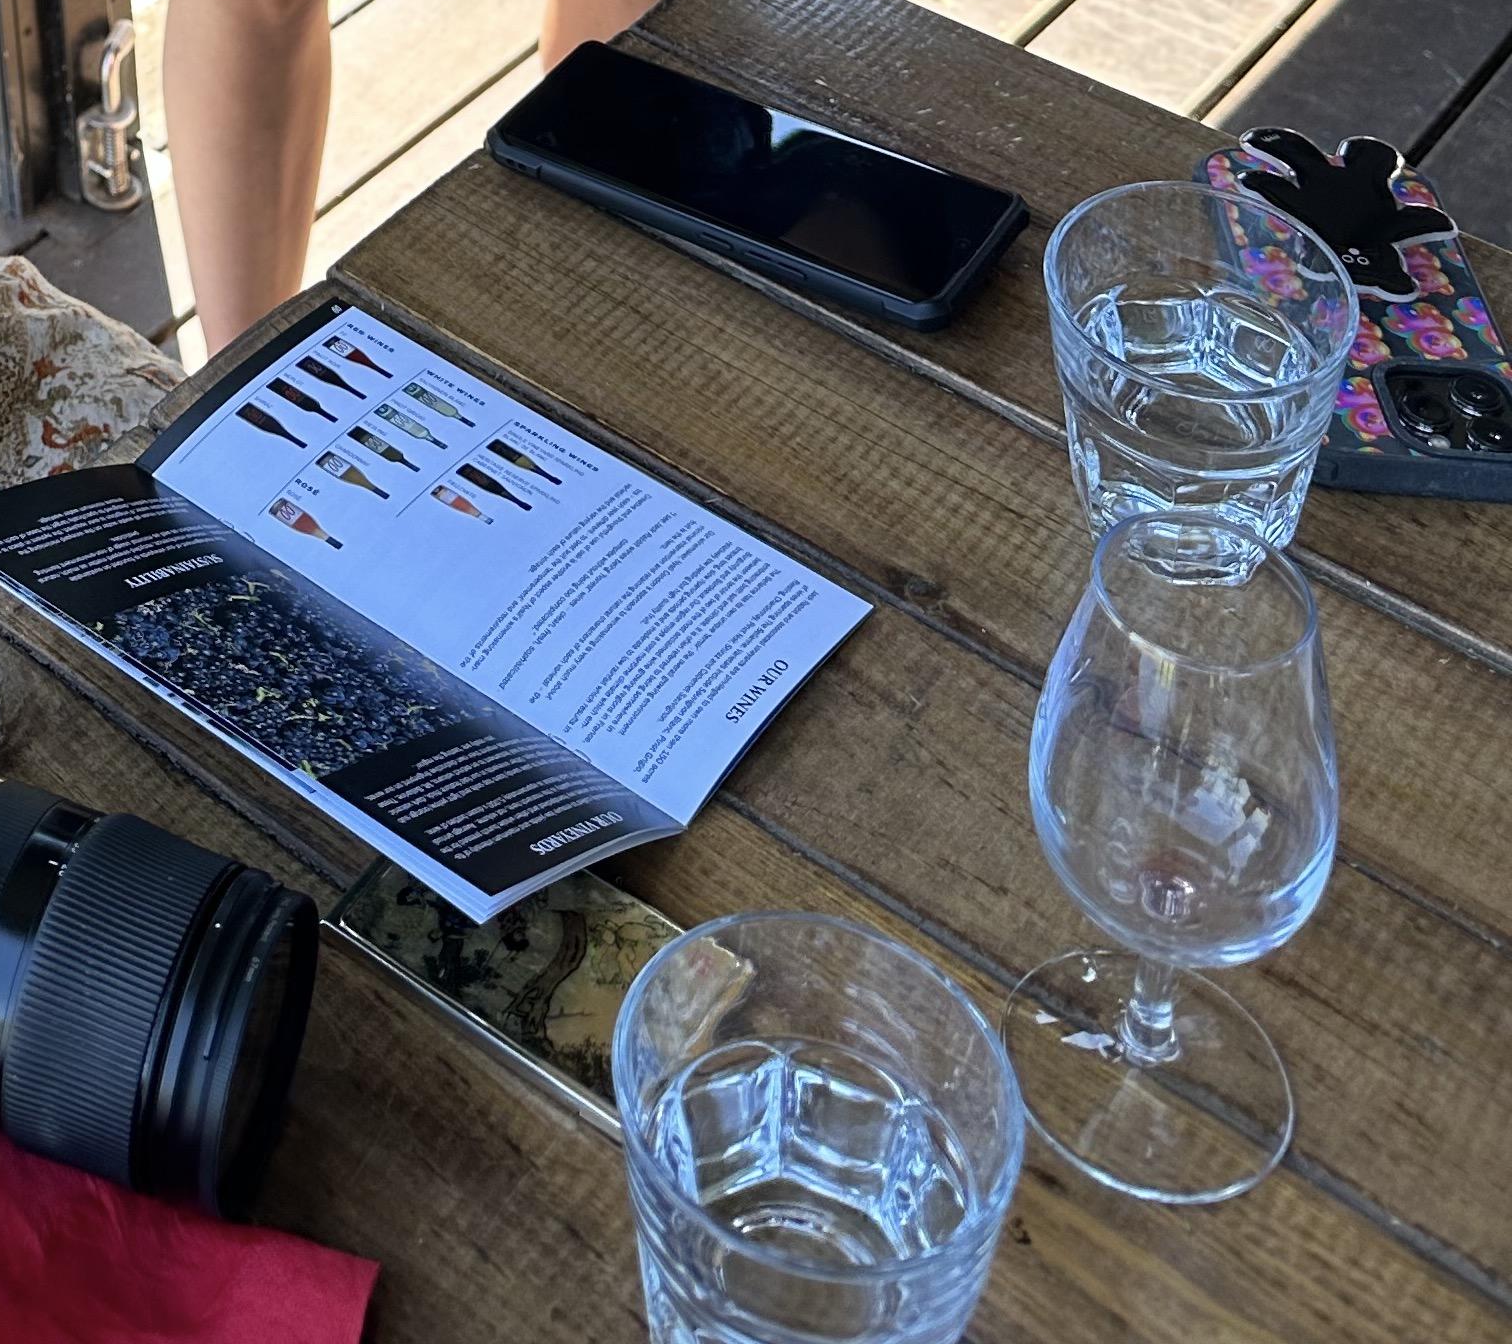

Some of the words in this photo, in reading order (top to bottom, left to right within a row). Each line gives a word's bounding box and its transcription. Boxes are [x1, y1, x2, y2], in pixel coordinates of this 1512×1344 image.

[124, 553, 224, 588] SUSTAINABILITY
[757, 659, 789, 685] OUR
[725, 685, 767, 724] WINES
[653, 748, 671, 765] 150
[638, 763, 660, 784] acres
[590, 812, 624, 827] OUR
[530, 820, 601, 855] VINEYARDS
